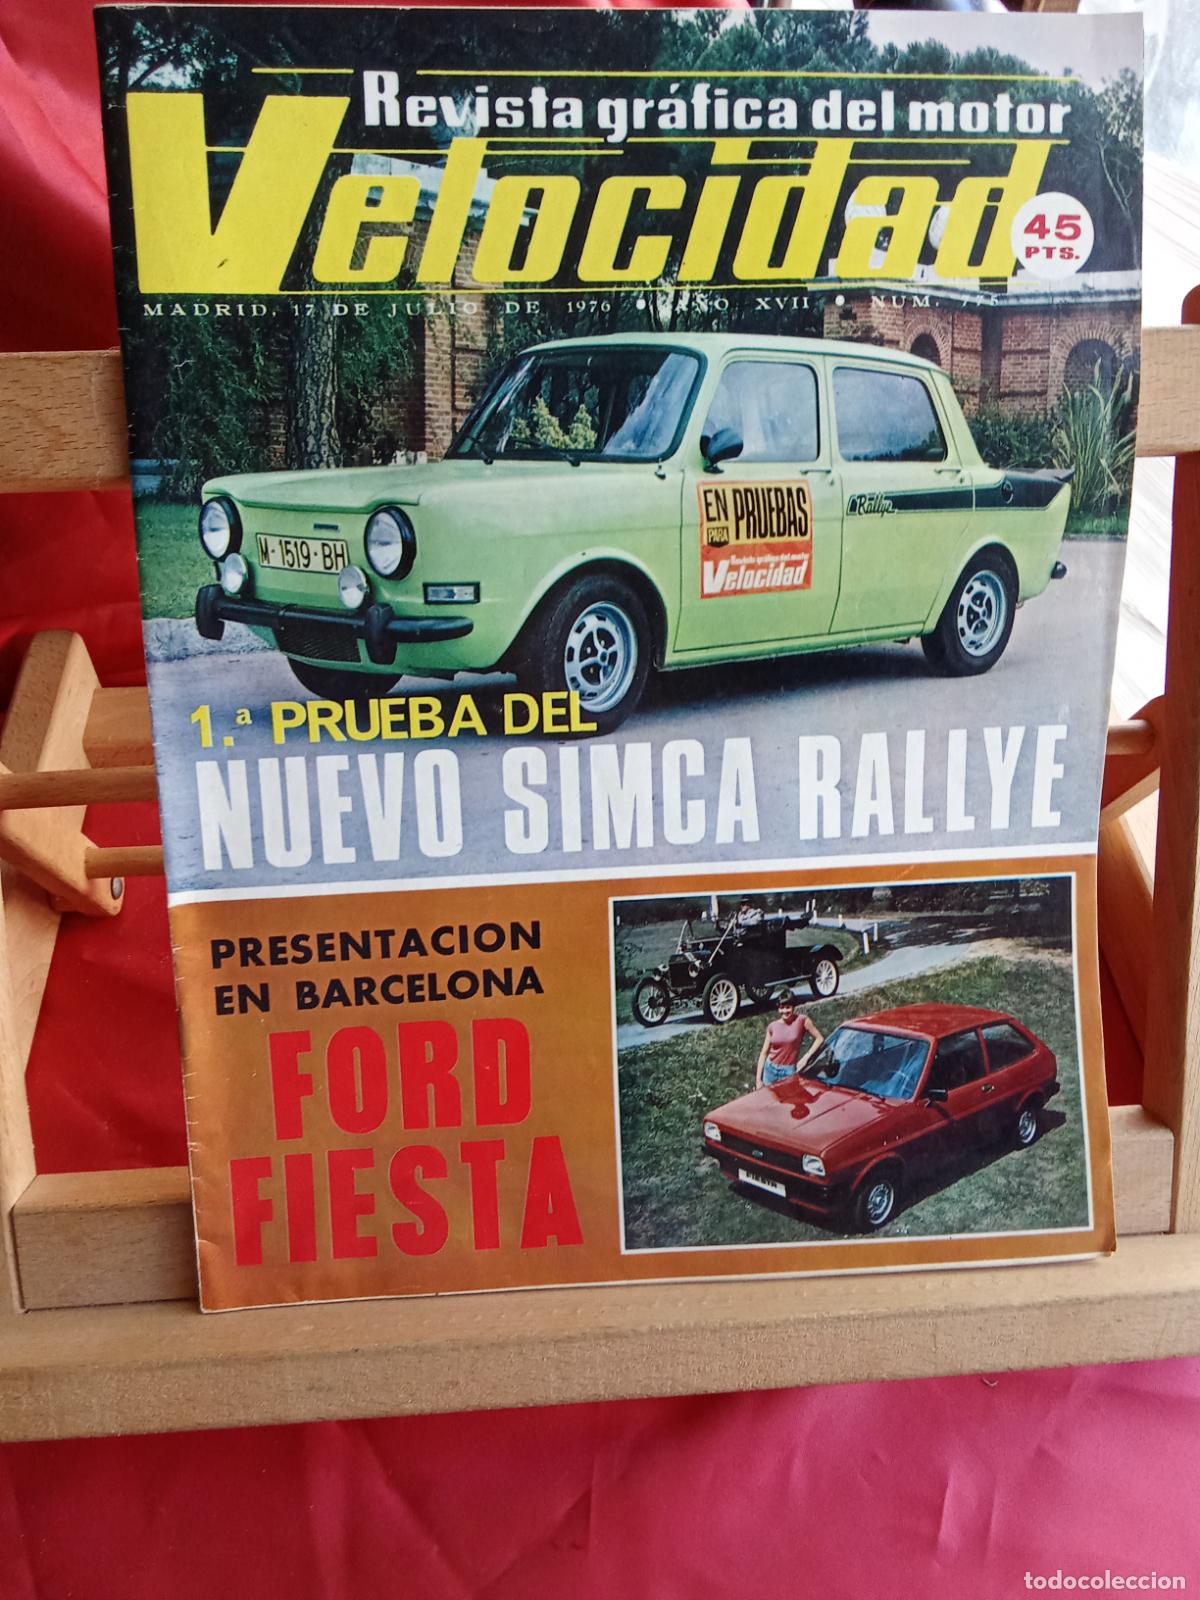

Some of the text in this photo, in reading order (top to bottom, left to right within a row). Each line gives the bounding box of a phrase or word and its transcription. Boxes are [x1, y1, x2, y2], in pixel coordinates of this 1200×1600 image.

[363, 70, 1071, 143] Revista gráfica del motor
[126, 91, 1055, 294] Velocidad
[1023, 213, 1082, 241] 45
[1025, 246, 1080, 260] PTS.
[143, 303, 277, 317] MADRID,
[293, 303, 315, 317] 17
[333, 303, 370, 317] DE
[388, 301, 479, 317] JULIO
[504, 301, 541, 315] DE
[567, 300, 612, 314] 1976
[755, 296, 810, 311] XVII
[870, 294, 940, 308] NUM.
[703, 487, 809, 541] EN PRUEBAS
[703, 559, 810, 595] Velocidad
[271, 695, 488, 745] PRUEBA
[504, 690, 597, 735] DEL
[196, 724, 1069, 871] NUEVO SIMCA RALLYE
[211, 920, 541, 969] PRESENTACION
[215, 966, 545, 1016] EN BARCELONA
[268, 1017, 533, 1141] FORD
[230, 1135, 585, 1267] FIESTA
